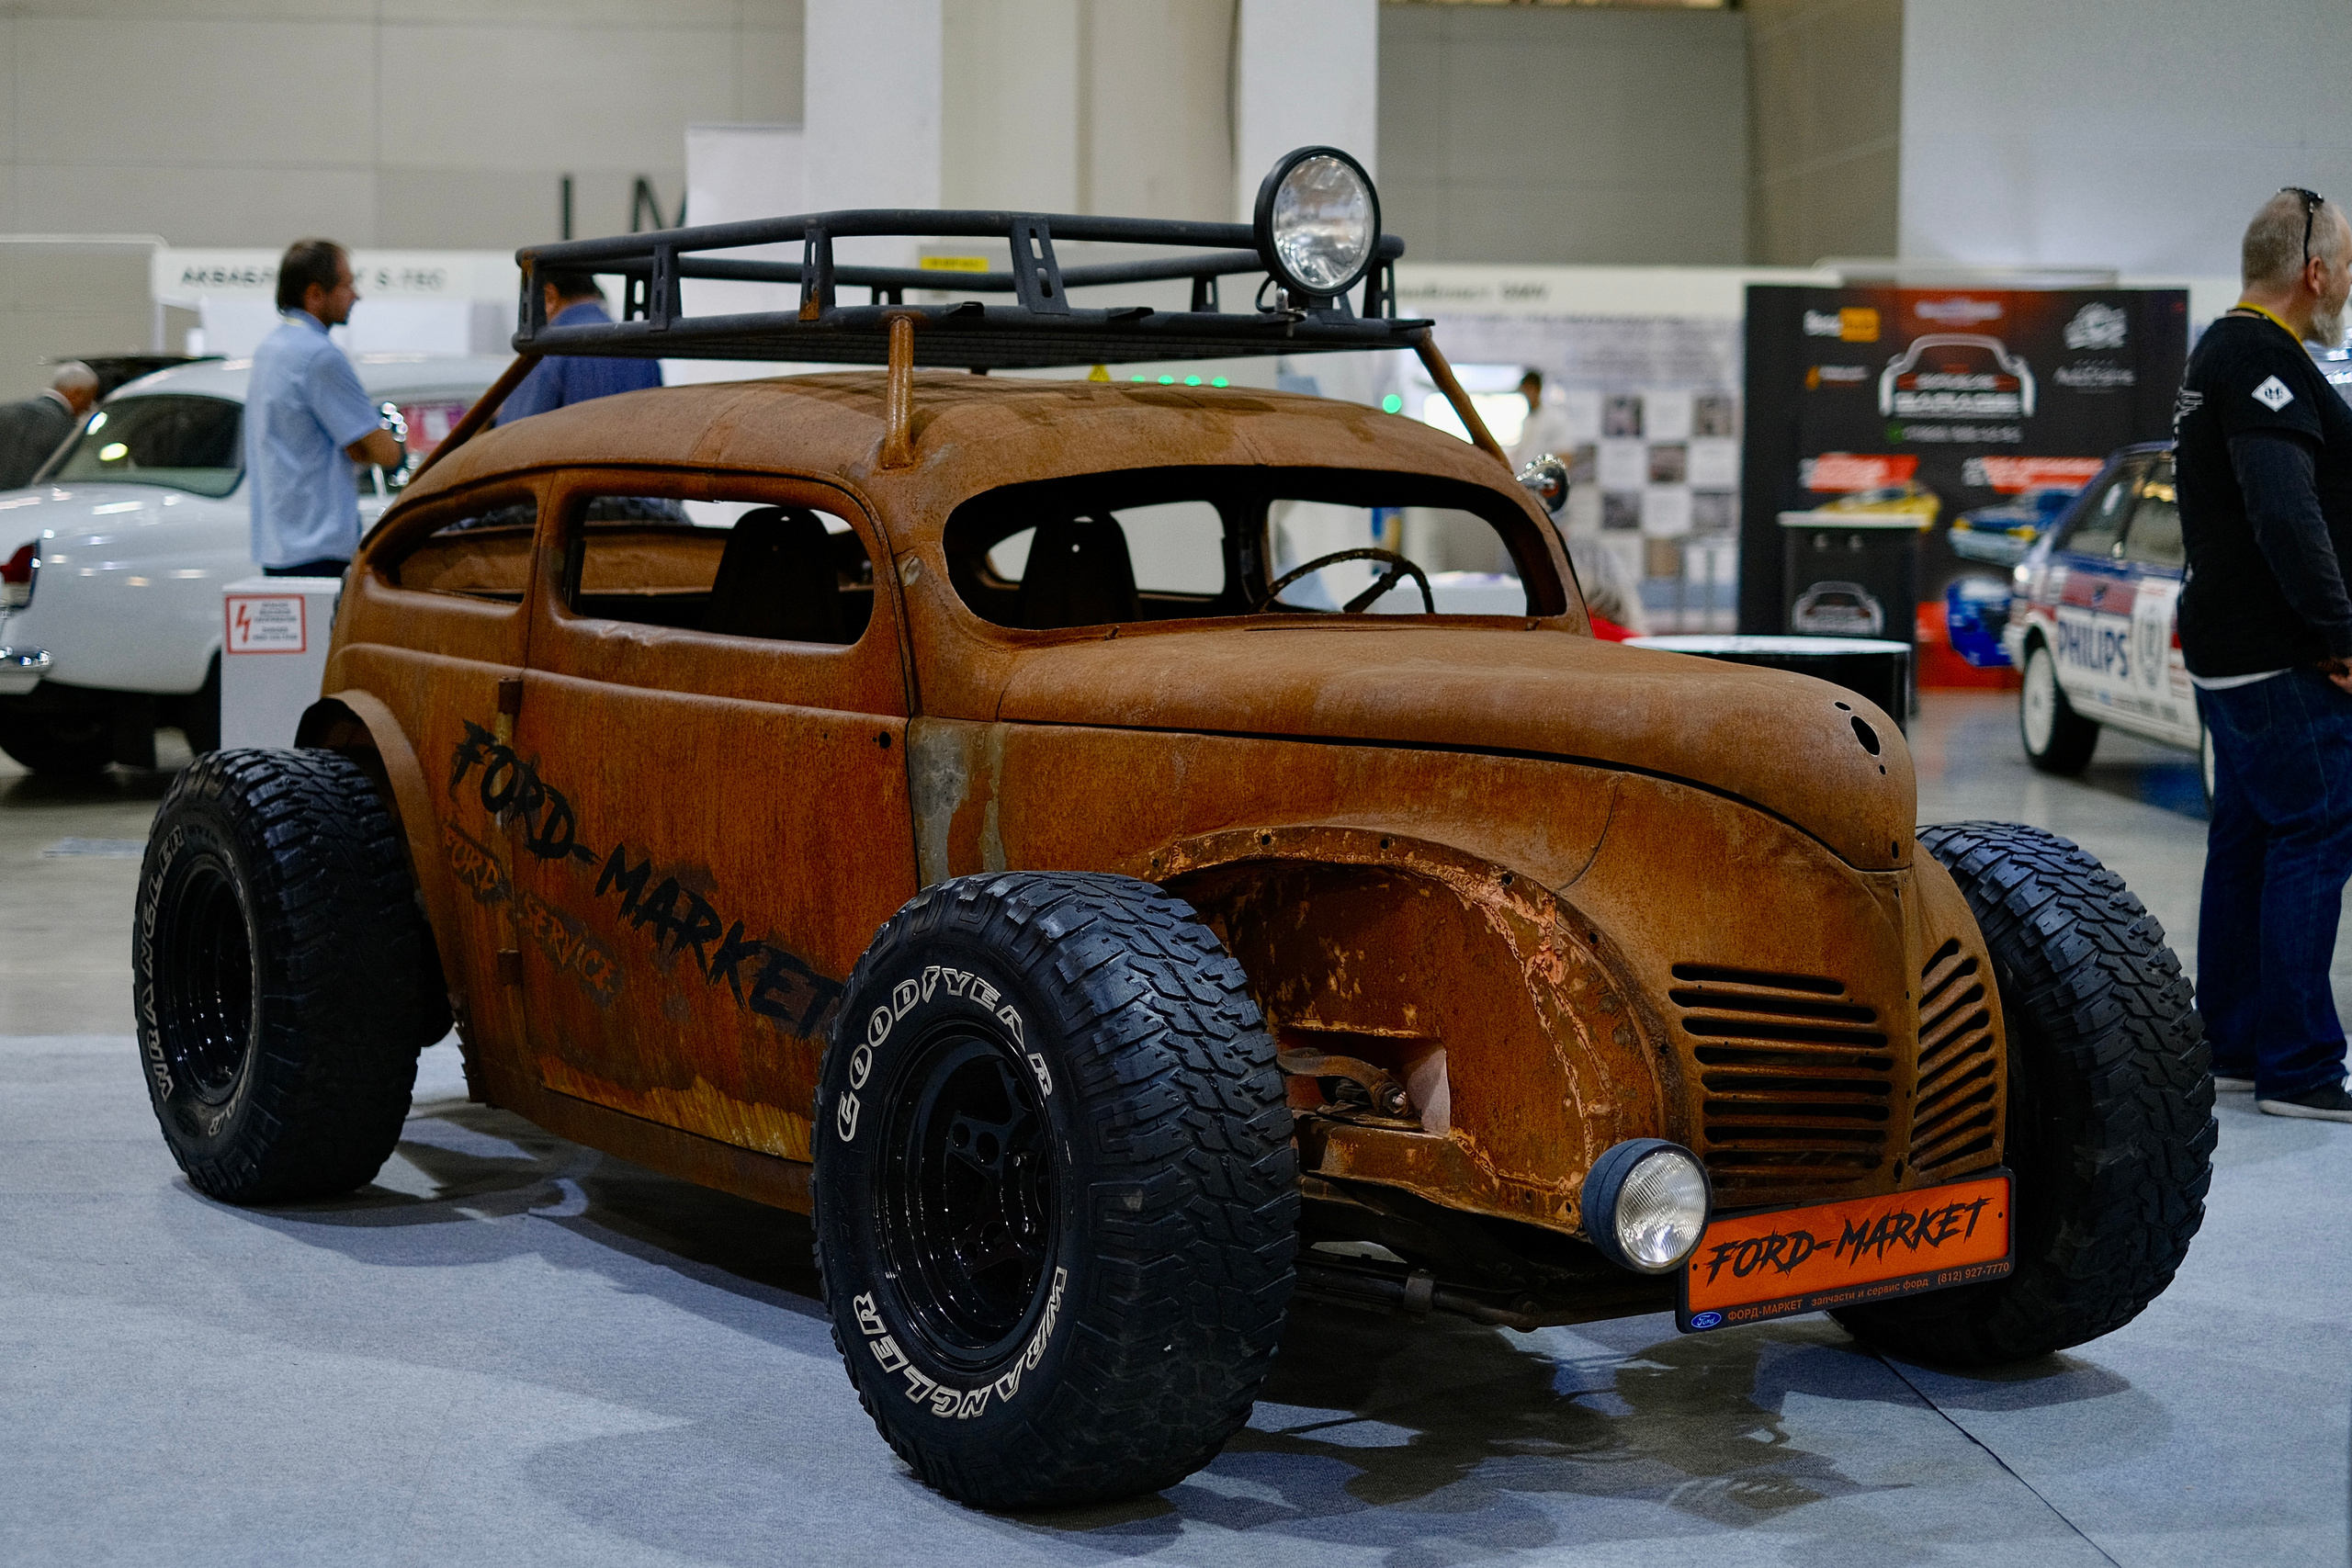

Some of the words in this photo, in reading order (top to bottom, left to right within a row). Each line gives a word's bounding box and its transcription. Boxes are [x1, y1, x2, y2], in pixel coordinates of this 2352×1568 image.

[2058, 619, 2130, 679] PHILIPS
[450, 719, 847, 1041] FORD-MARKET
[140, 824, 186, 1103] WRANGLER
[836, 964, 1053, 1143] GOODYEAR
[1705, 1195, 1994, 1288] FORD-MARKET
[1727, 1299, 1803, 1322] ФОРД-МАРКЕТ
[1811, 1292, 1855, 1307] запчасти
[1858, 1290, 1865, 1298] и
[1867, 1283, 1900, 1298] сервис
[1903, 1278, 1929, 1292] форд
[1938, 1271, 1962, 1285] (812)
[1964, 1261, 2010, 1279] 927-7770
[853, 1267, 1069, 1420] WRANGLER
